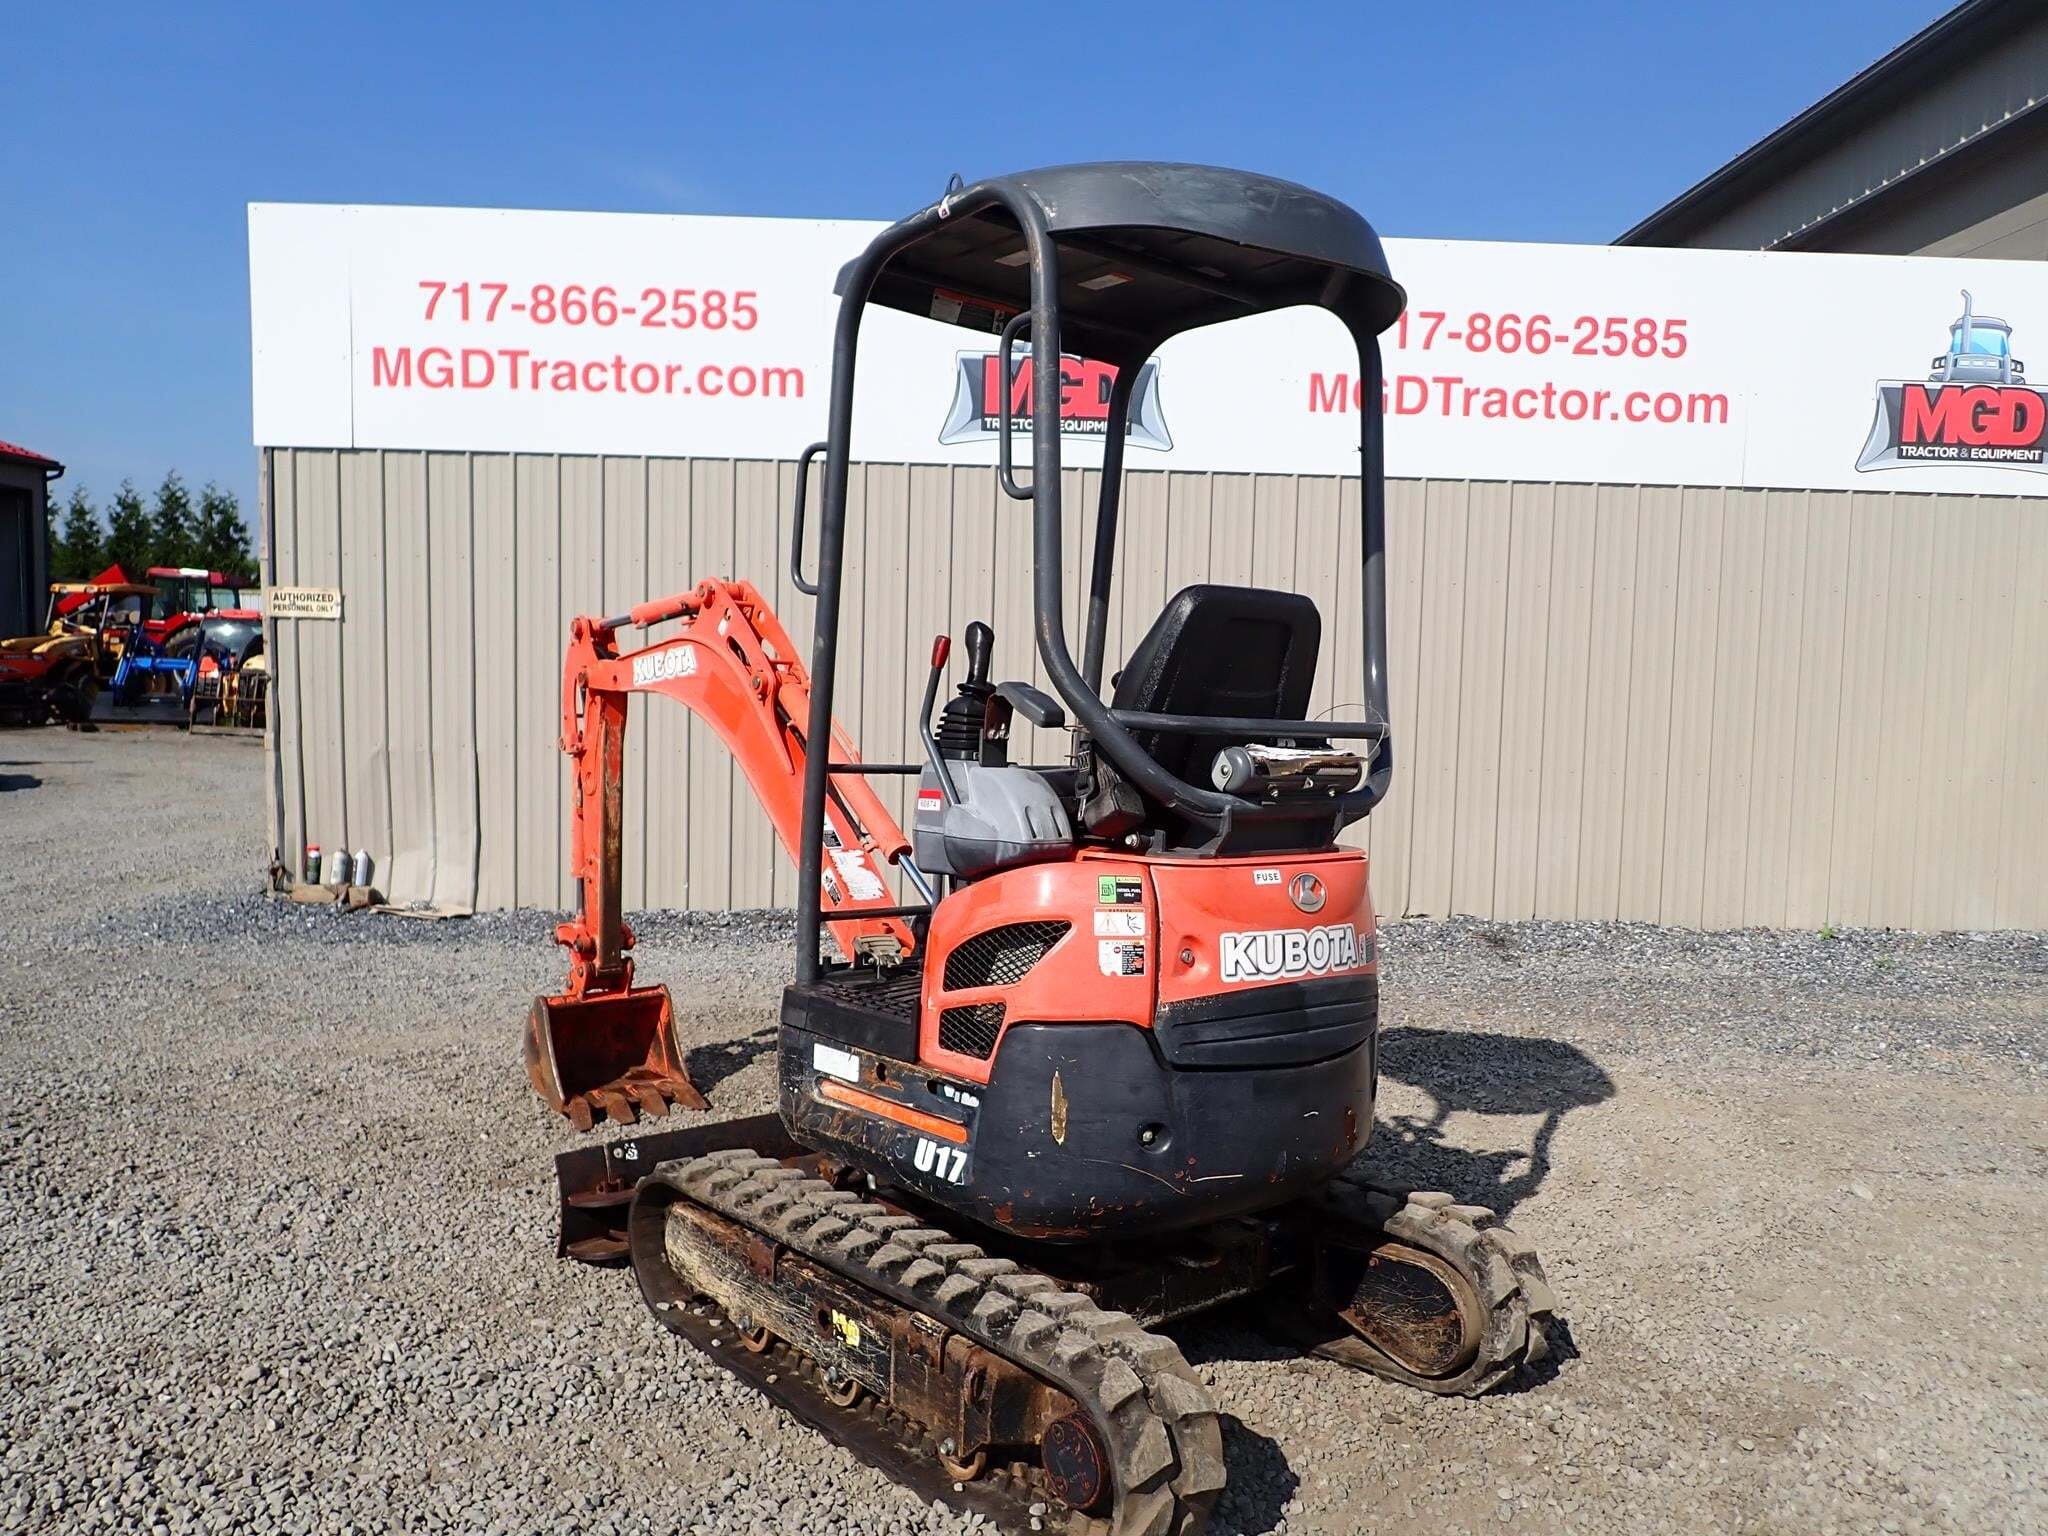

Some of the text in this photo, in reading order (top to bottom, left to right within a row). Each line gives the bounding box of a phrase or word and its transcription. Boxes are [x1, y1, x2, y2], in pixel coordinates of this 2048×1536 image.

[418, 281, 758, 331] 717-866-2585
[1397, 310, 1688, 358] 17-866-2585
[372, 346, 805, 398] MGDTractor.com
[984, 418, 1033, 431] TRCTO
[1902, 385, 2046, 446] MGD
[1901, 446, 2042, 461] TRACTOR & EQUIPMENT
[273, 592, 334, 602] AUTHORIZED
[273, 603, 314, 612] PERSONNEL
[634, 648, 696, 684] KUBOTA
[1256, 873, 1279, 881] FUSE
[1224, 927, 1357, 976] KUBOTA
[913, 1138, 967, 1183] U17
